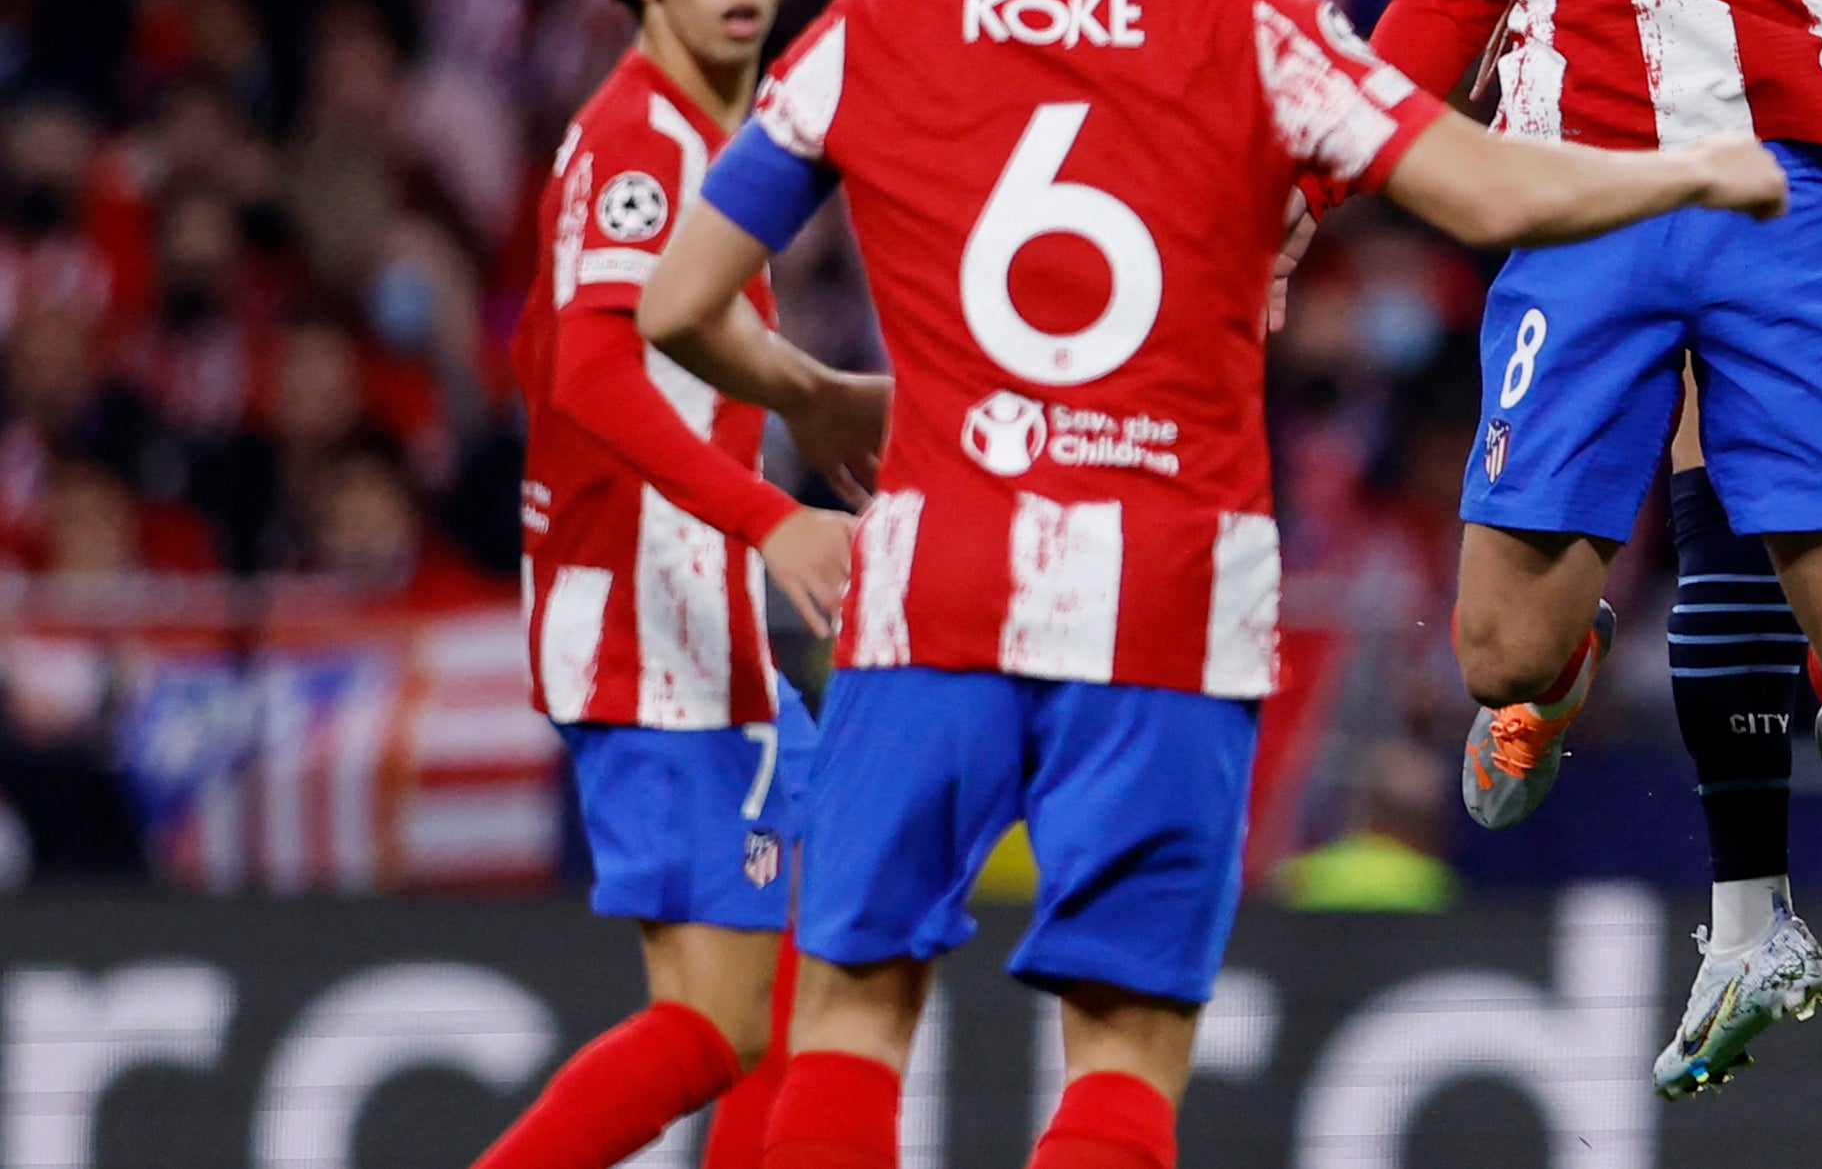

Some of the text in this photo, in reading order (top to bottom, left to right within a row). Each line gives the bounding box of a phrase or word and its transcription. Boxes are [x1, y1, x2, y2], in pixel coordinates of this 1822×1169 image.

[960, 102, 1163, 387] 6
[1500, 307, 1548, 410] 8
[1123, 413, 1179, 446] the
[741, 721, 778, 820] 7
[1729, 712, 1789, 734] CITY
